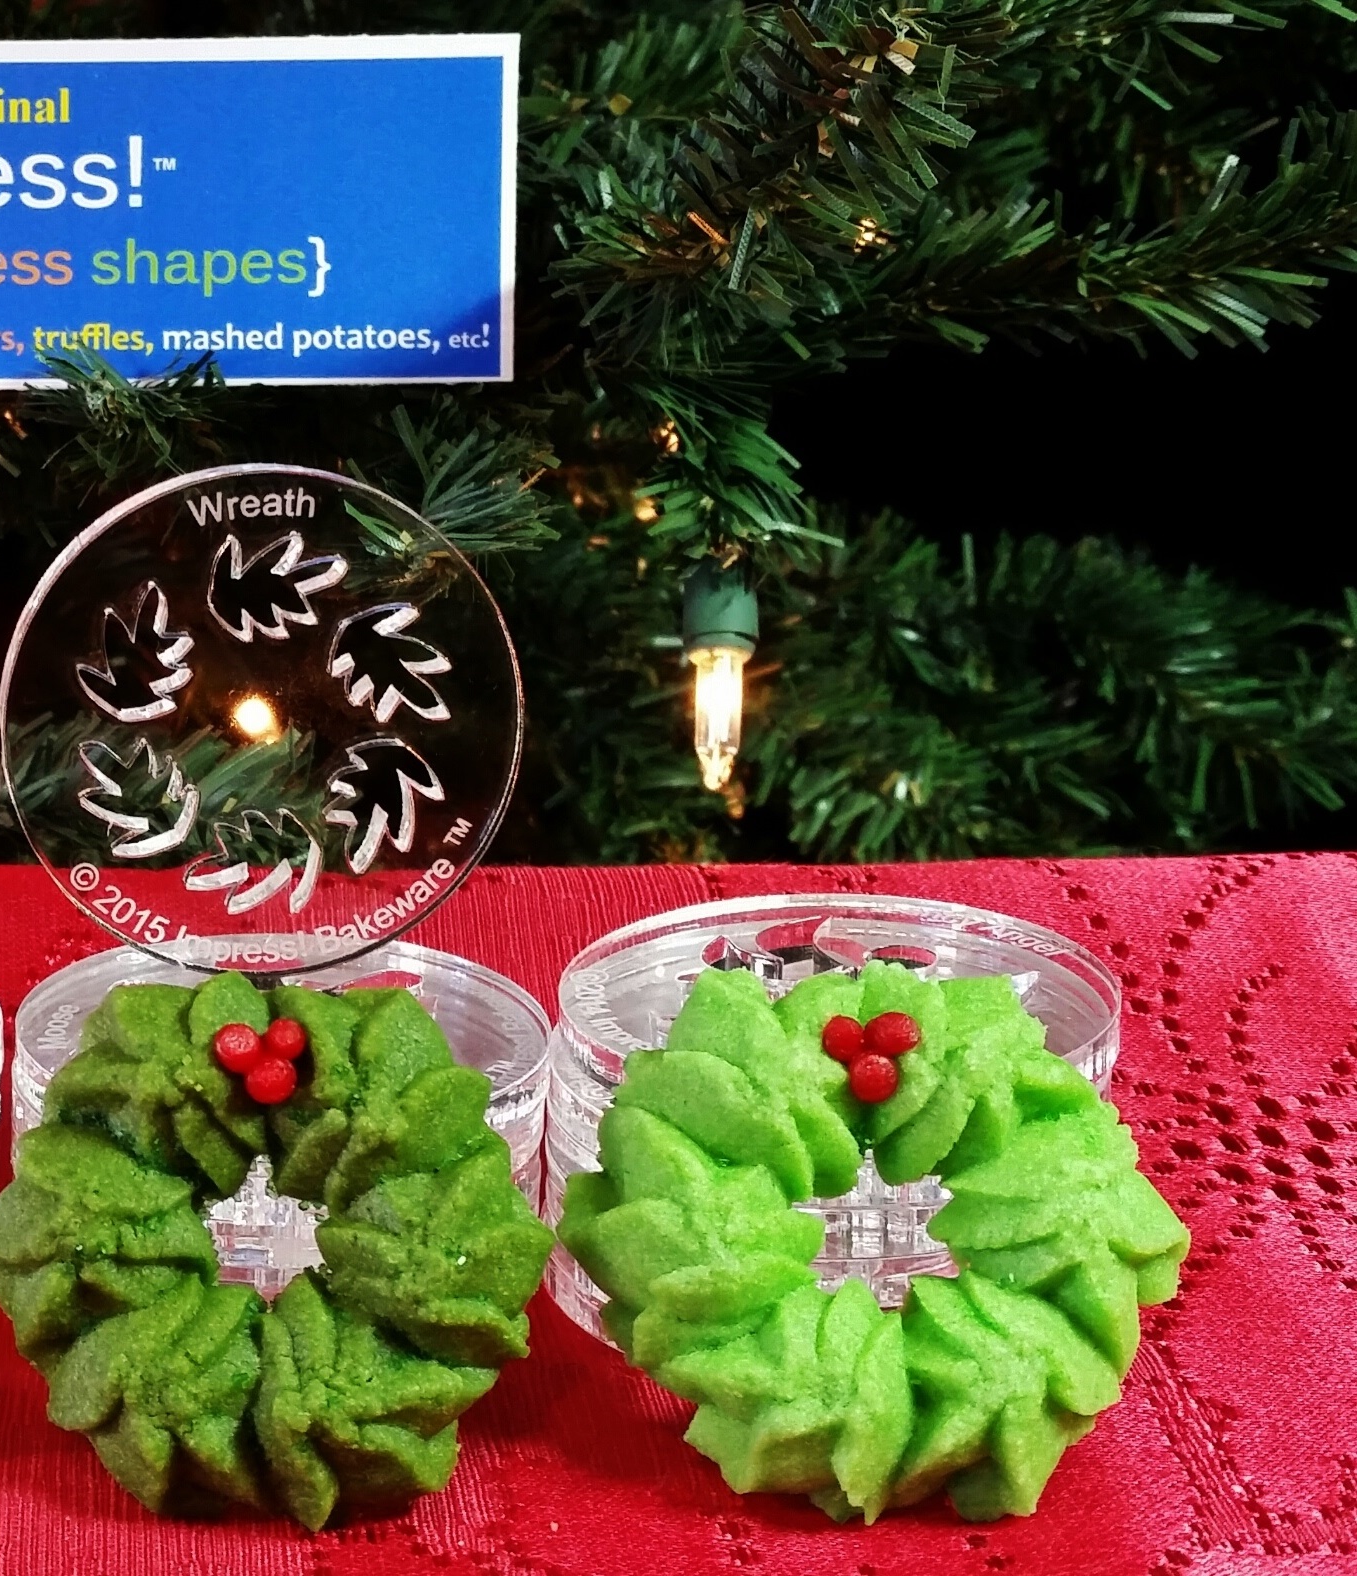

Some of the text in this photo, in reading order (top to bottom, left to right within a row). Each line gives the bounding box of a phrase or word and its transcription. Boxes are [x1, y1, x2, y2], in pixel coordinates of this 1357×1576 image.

[90, 236, 333, 299] shapes}
[33, 322, 155, 357] truffles,
[162, 323, 284, 352] mashed
[292, 325, 441, 359] potatoes,
[449, 324, 491, 351] etc!
[185, 487, 316, 527] Wreath
[90, 884, 171, 945] 2015
[173, 923, 307, 964] Impress!
[313, 857, 457, 954] Bakeware
[978, 920, 1072, 957] Angel
[36, 1003, 81, 1051] Moose
